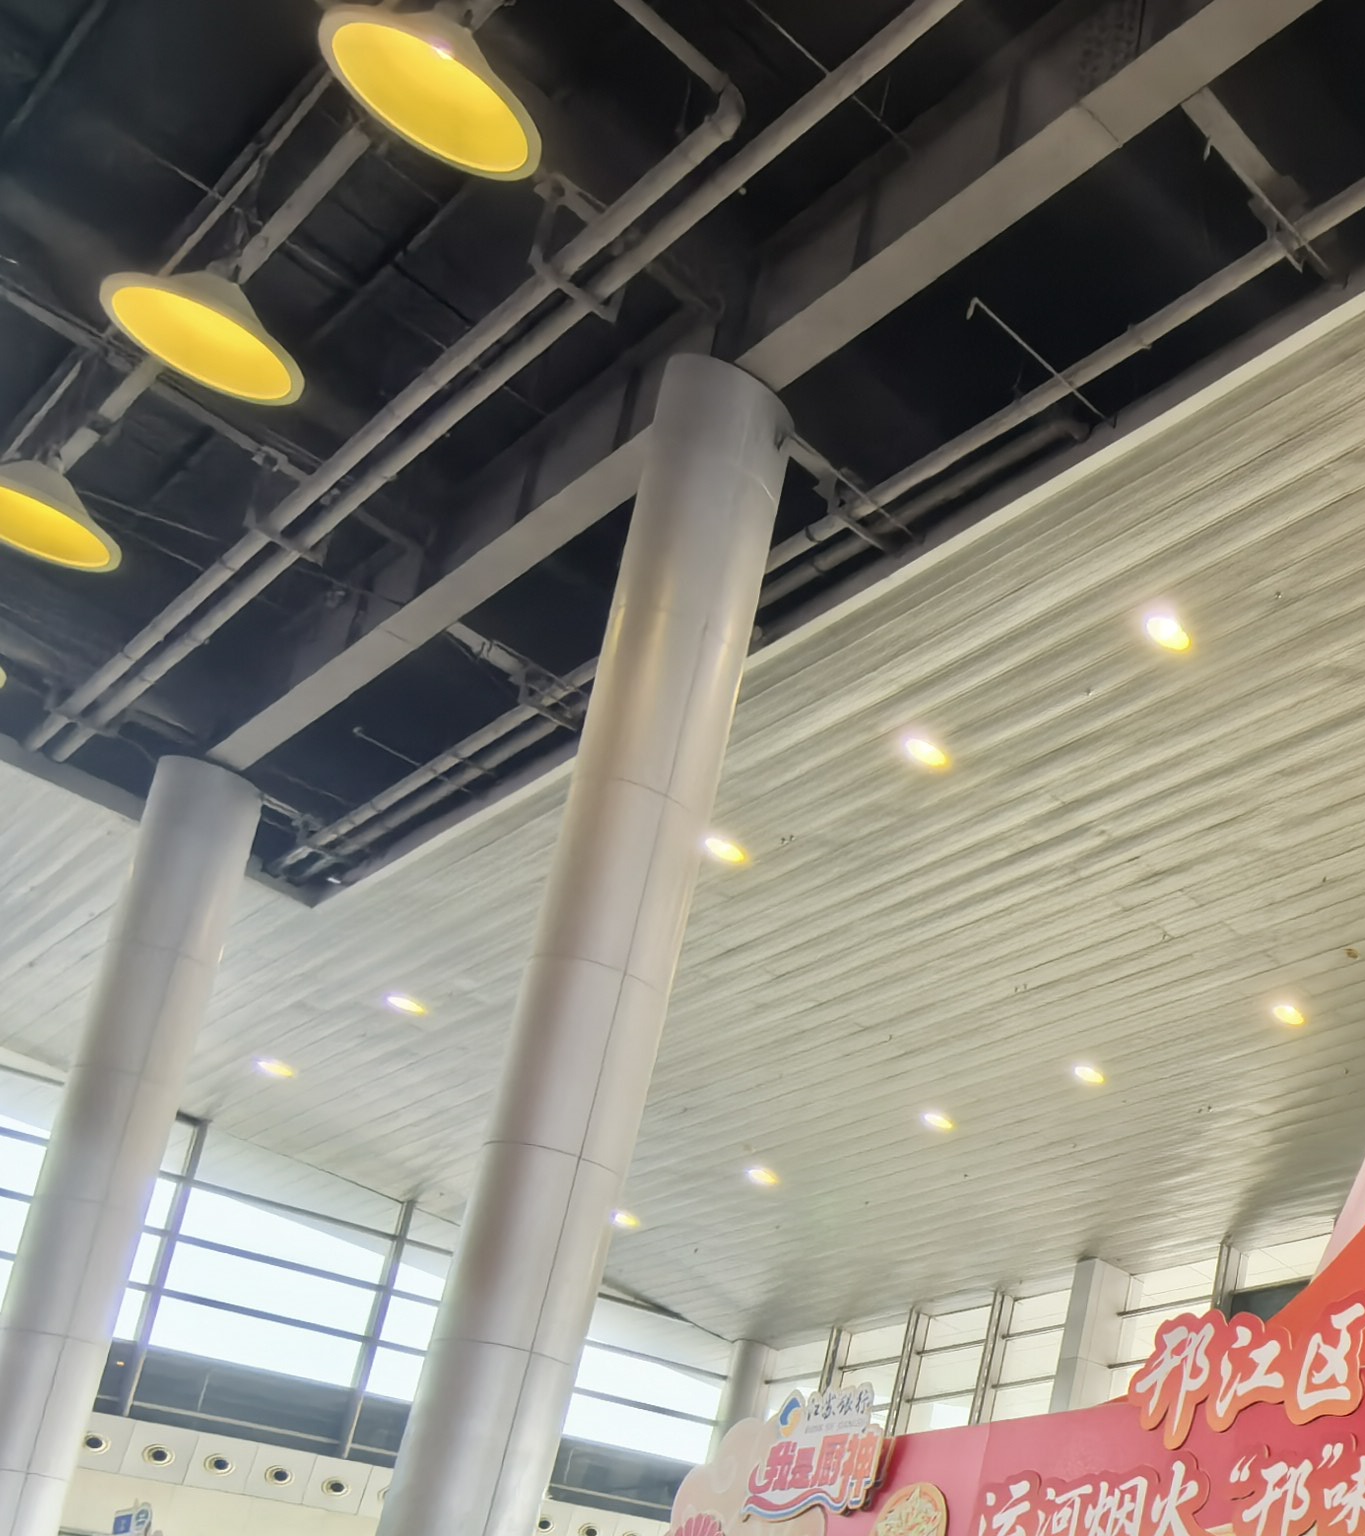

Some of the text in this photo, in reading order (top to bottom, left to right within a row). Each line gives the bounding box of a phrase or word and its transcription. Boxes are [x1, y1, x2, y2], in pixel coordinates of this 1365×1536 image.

[806, 1389, 872, 1422] 江苏银行
[1135, 1302, 1365, 1437] 邗江区
[748, 1431, 879, 1503] 我是厨神
